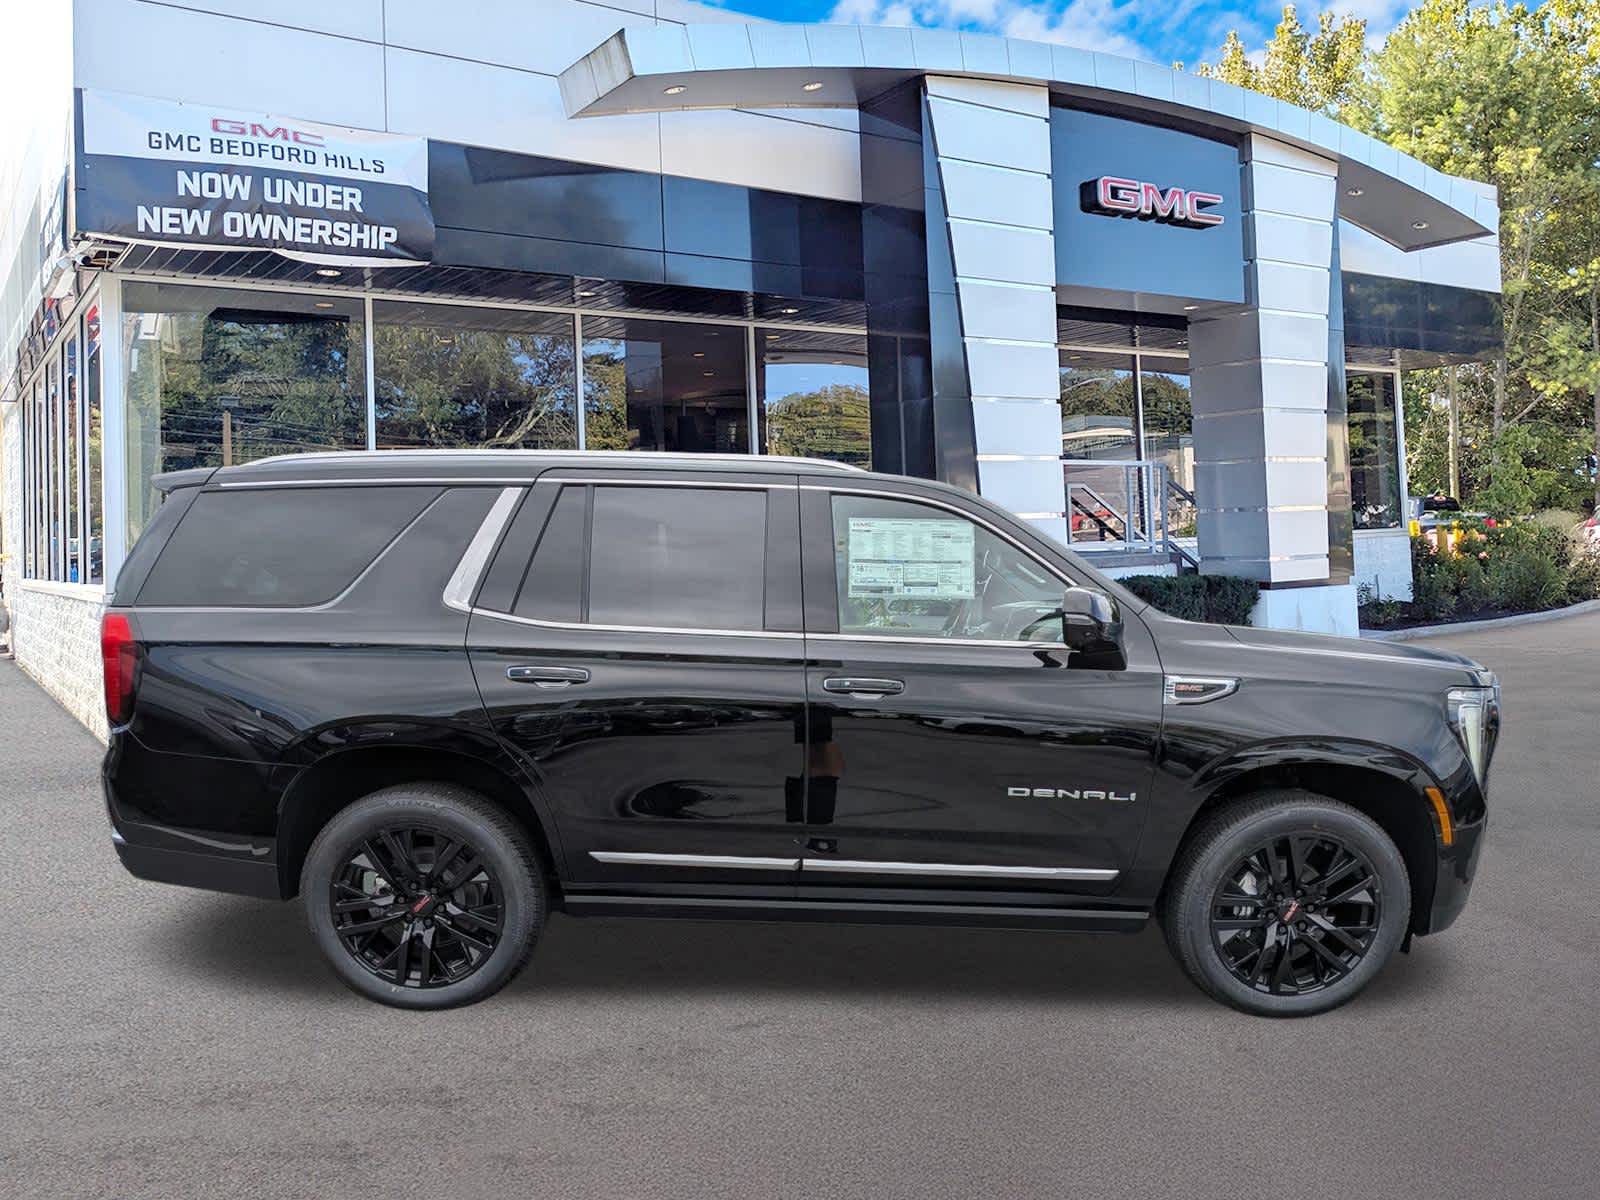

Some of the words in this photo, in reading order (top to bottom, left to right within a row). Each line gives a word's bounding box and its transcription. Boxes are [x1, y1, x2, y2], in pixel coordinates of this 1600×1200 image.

[147, 131, 201, 153] GMC
[211, 138, 316, 165] BEDFORD
[324, 153, 385, 174] HILLS
[211, 118, 326, 147] GMC
[177, 170, 252, 200] NOW
[263, 179, 363, 212] UNDER
[1097, 175, 1224, 224] GMC
[137, 205, 211, 235] NEW
[223, 212, 398, 250] OWNERSHIP
[1175, 684, 1203, 692] GMC
[1007, 786, 1137, 802] DENALI
